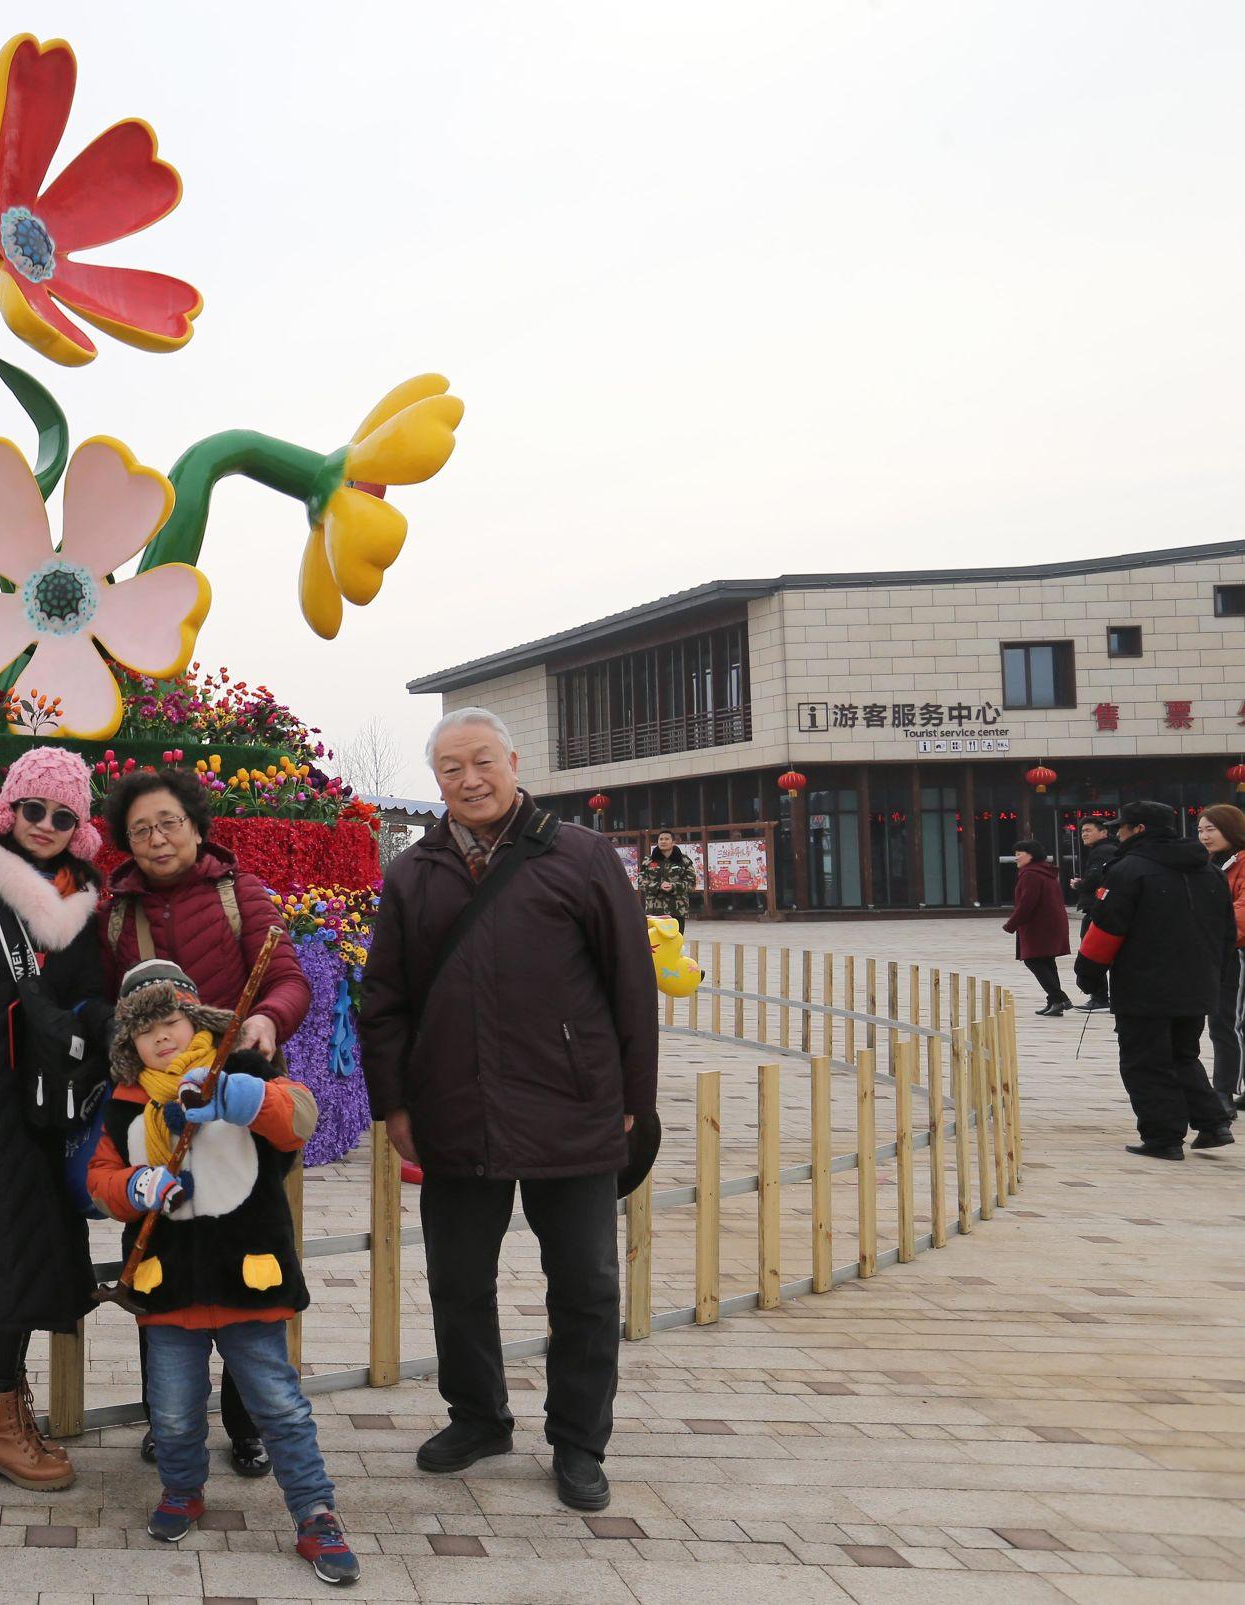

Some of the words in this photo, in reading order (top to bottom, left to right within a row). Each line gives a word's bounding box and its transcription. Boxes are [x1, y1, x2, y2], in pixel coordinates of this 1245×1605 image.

[832, 701, 1001, 729] 游客服务中心
[1093, 699, 1245, 732] 售票
[903, 728, 937, 738] Tourist
[939, 728, 975, 738] service
[977, 727, 1010, 737] center
